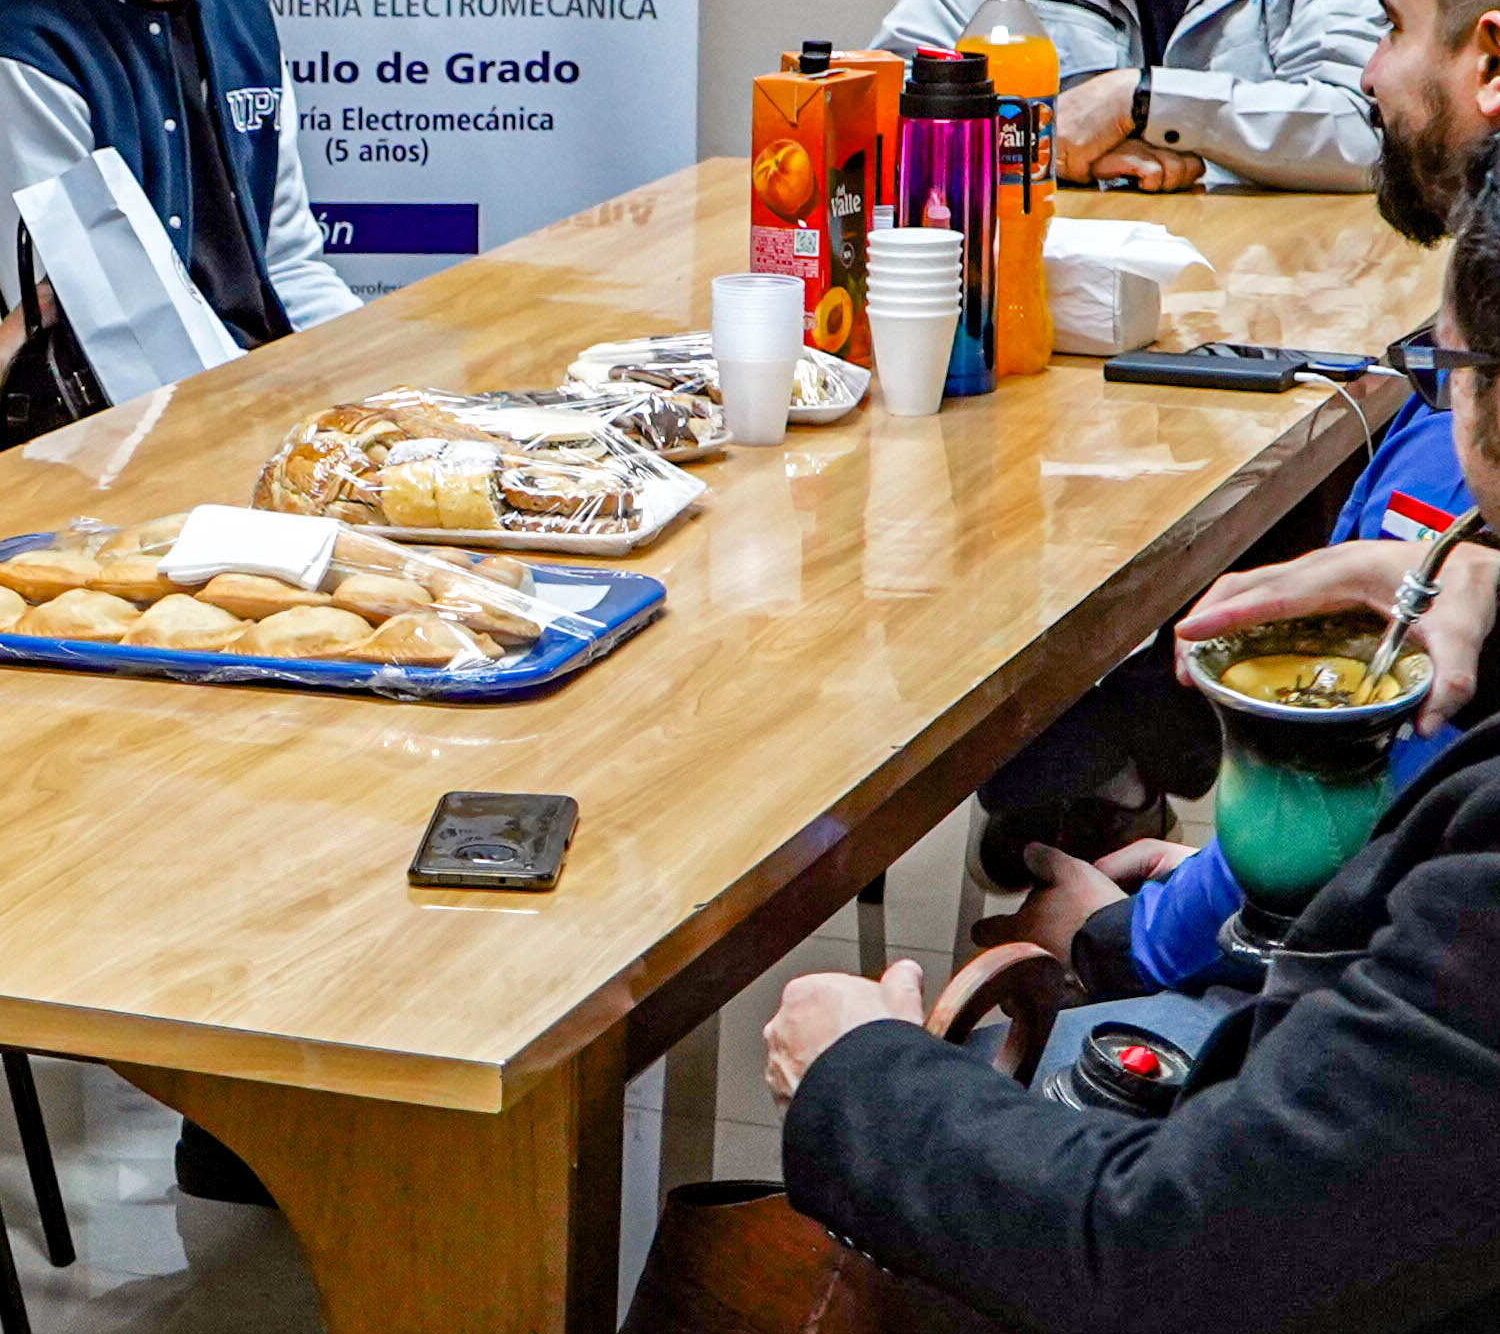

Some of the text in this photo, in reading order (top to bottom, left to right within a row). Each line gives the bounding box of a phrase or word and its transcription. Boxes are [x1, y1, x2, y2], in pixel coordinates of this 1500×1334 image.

[285, 50, 581, 85] ulo de Grado
[342, 105, 555, 132] Electromecánica
[324, 138, 430, 167] (5 años)
[830, 192, 862, 218] Valle
